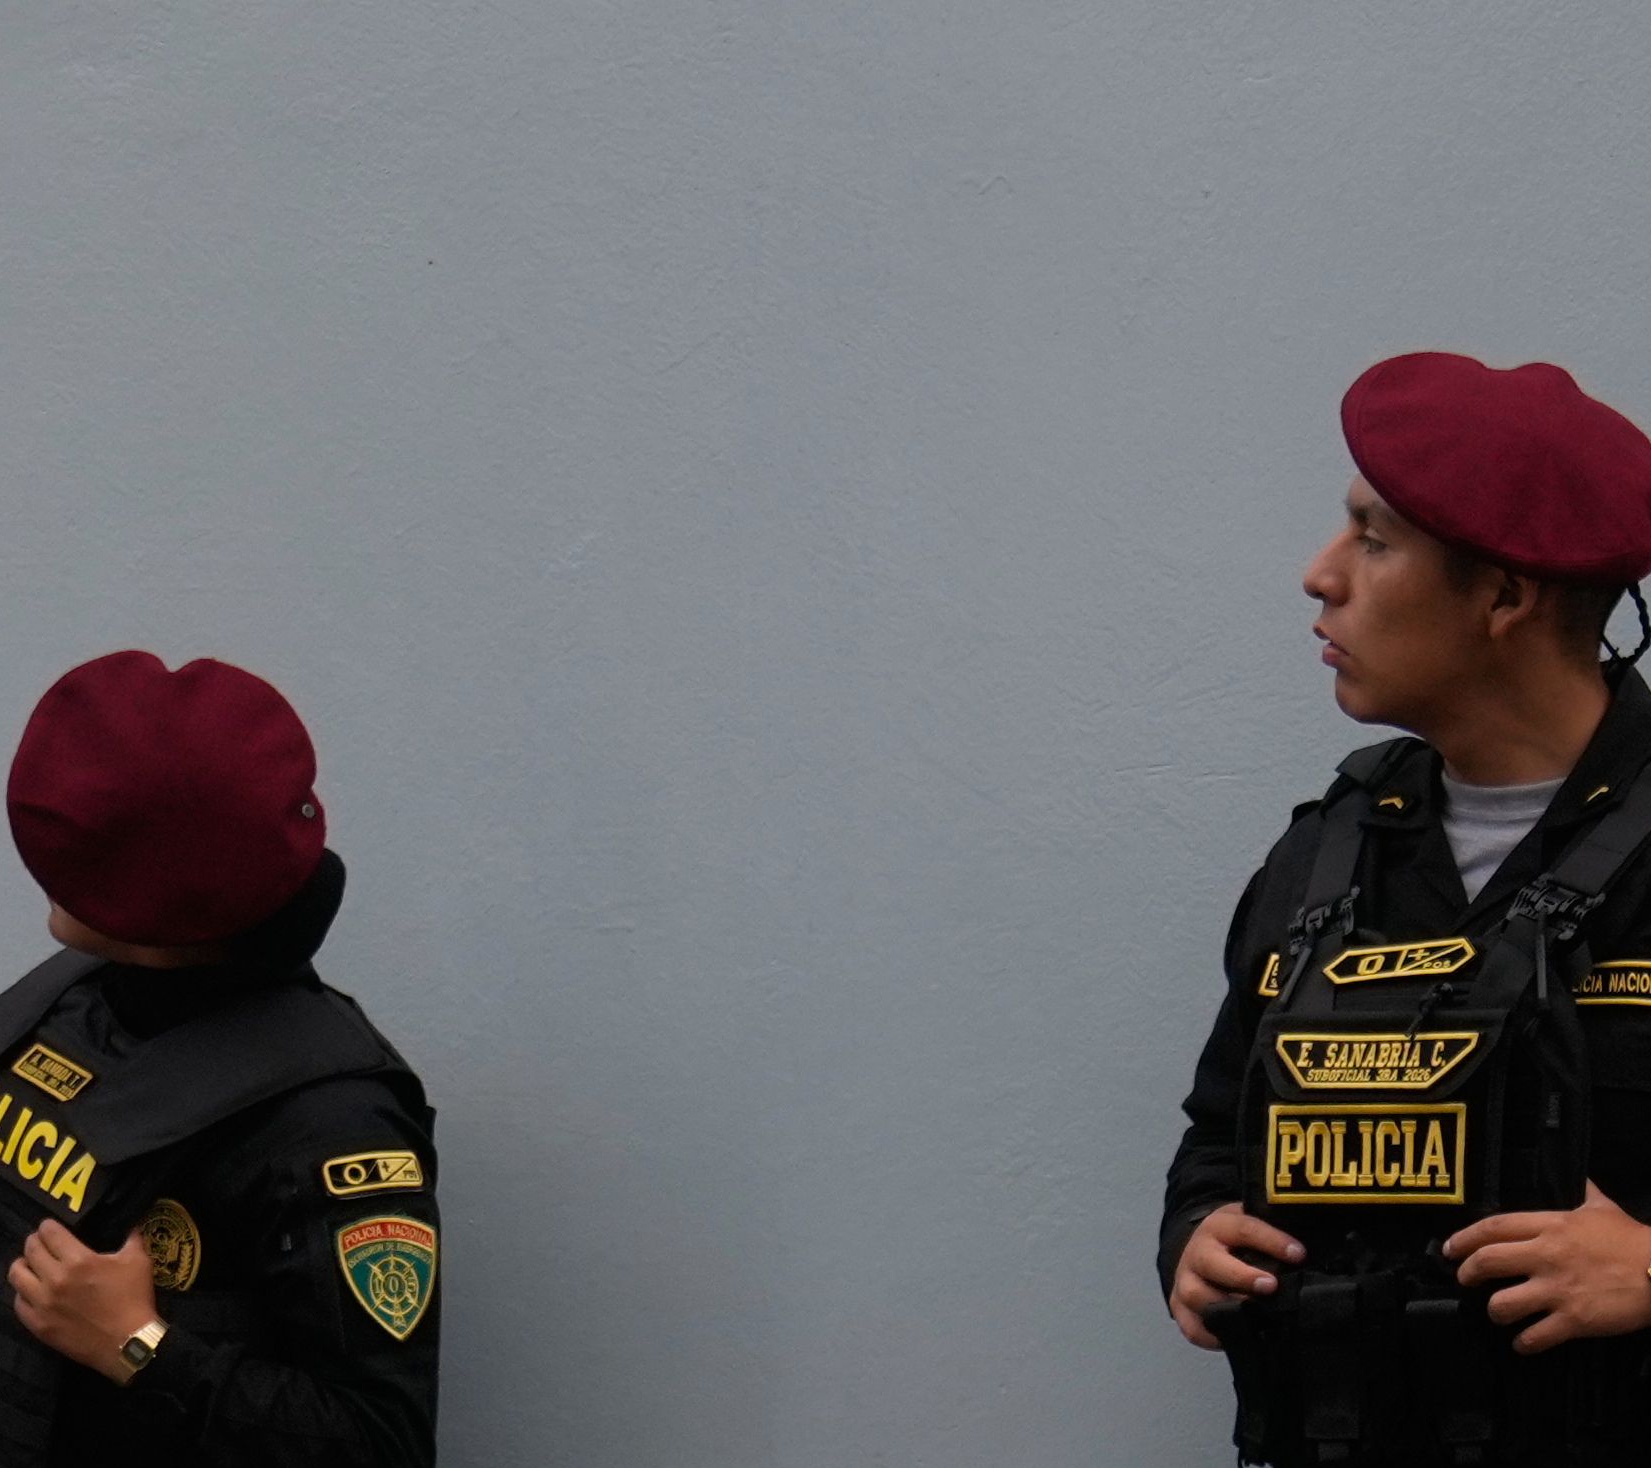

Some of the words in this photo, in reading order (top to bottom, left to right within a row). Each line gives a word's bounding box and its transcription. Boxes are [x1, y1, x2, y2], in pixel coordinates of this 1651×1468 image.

[1297, 1042, 1315, 1067] E.
[1324, 1041, 1423, 1068] SANABRIA
[1429, 1041, 1448, 1067] C.
[1306, 1068, 1371, 1083] SUBOFICIAL
[1403, 1068, 1433, 1082] 2026
[1276, 1119, 1451, 1188] POLICIA
[343, 1224, 385, 1248] POLICIA
[388, 1223, 433, 1247] NACIONAL
